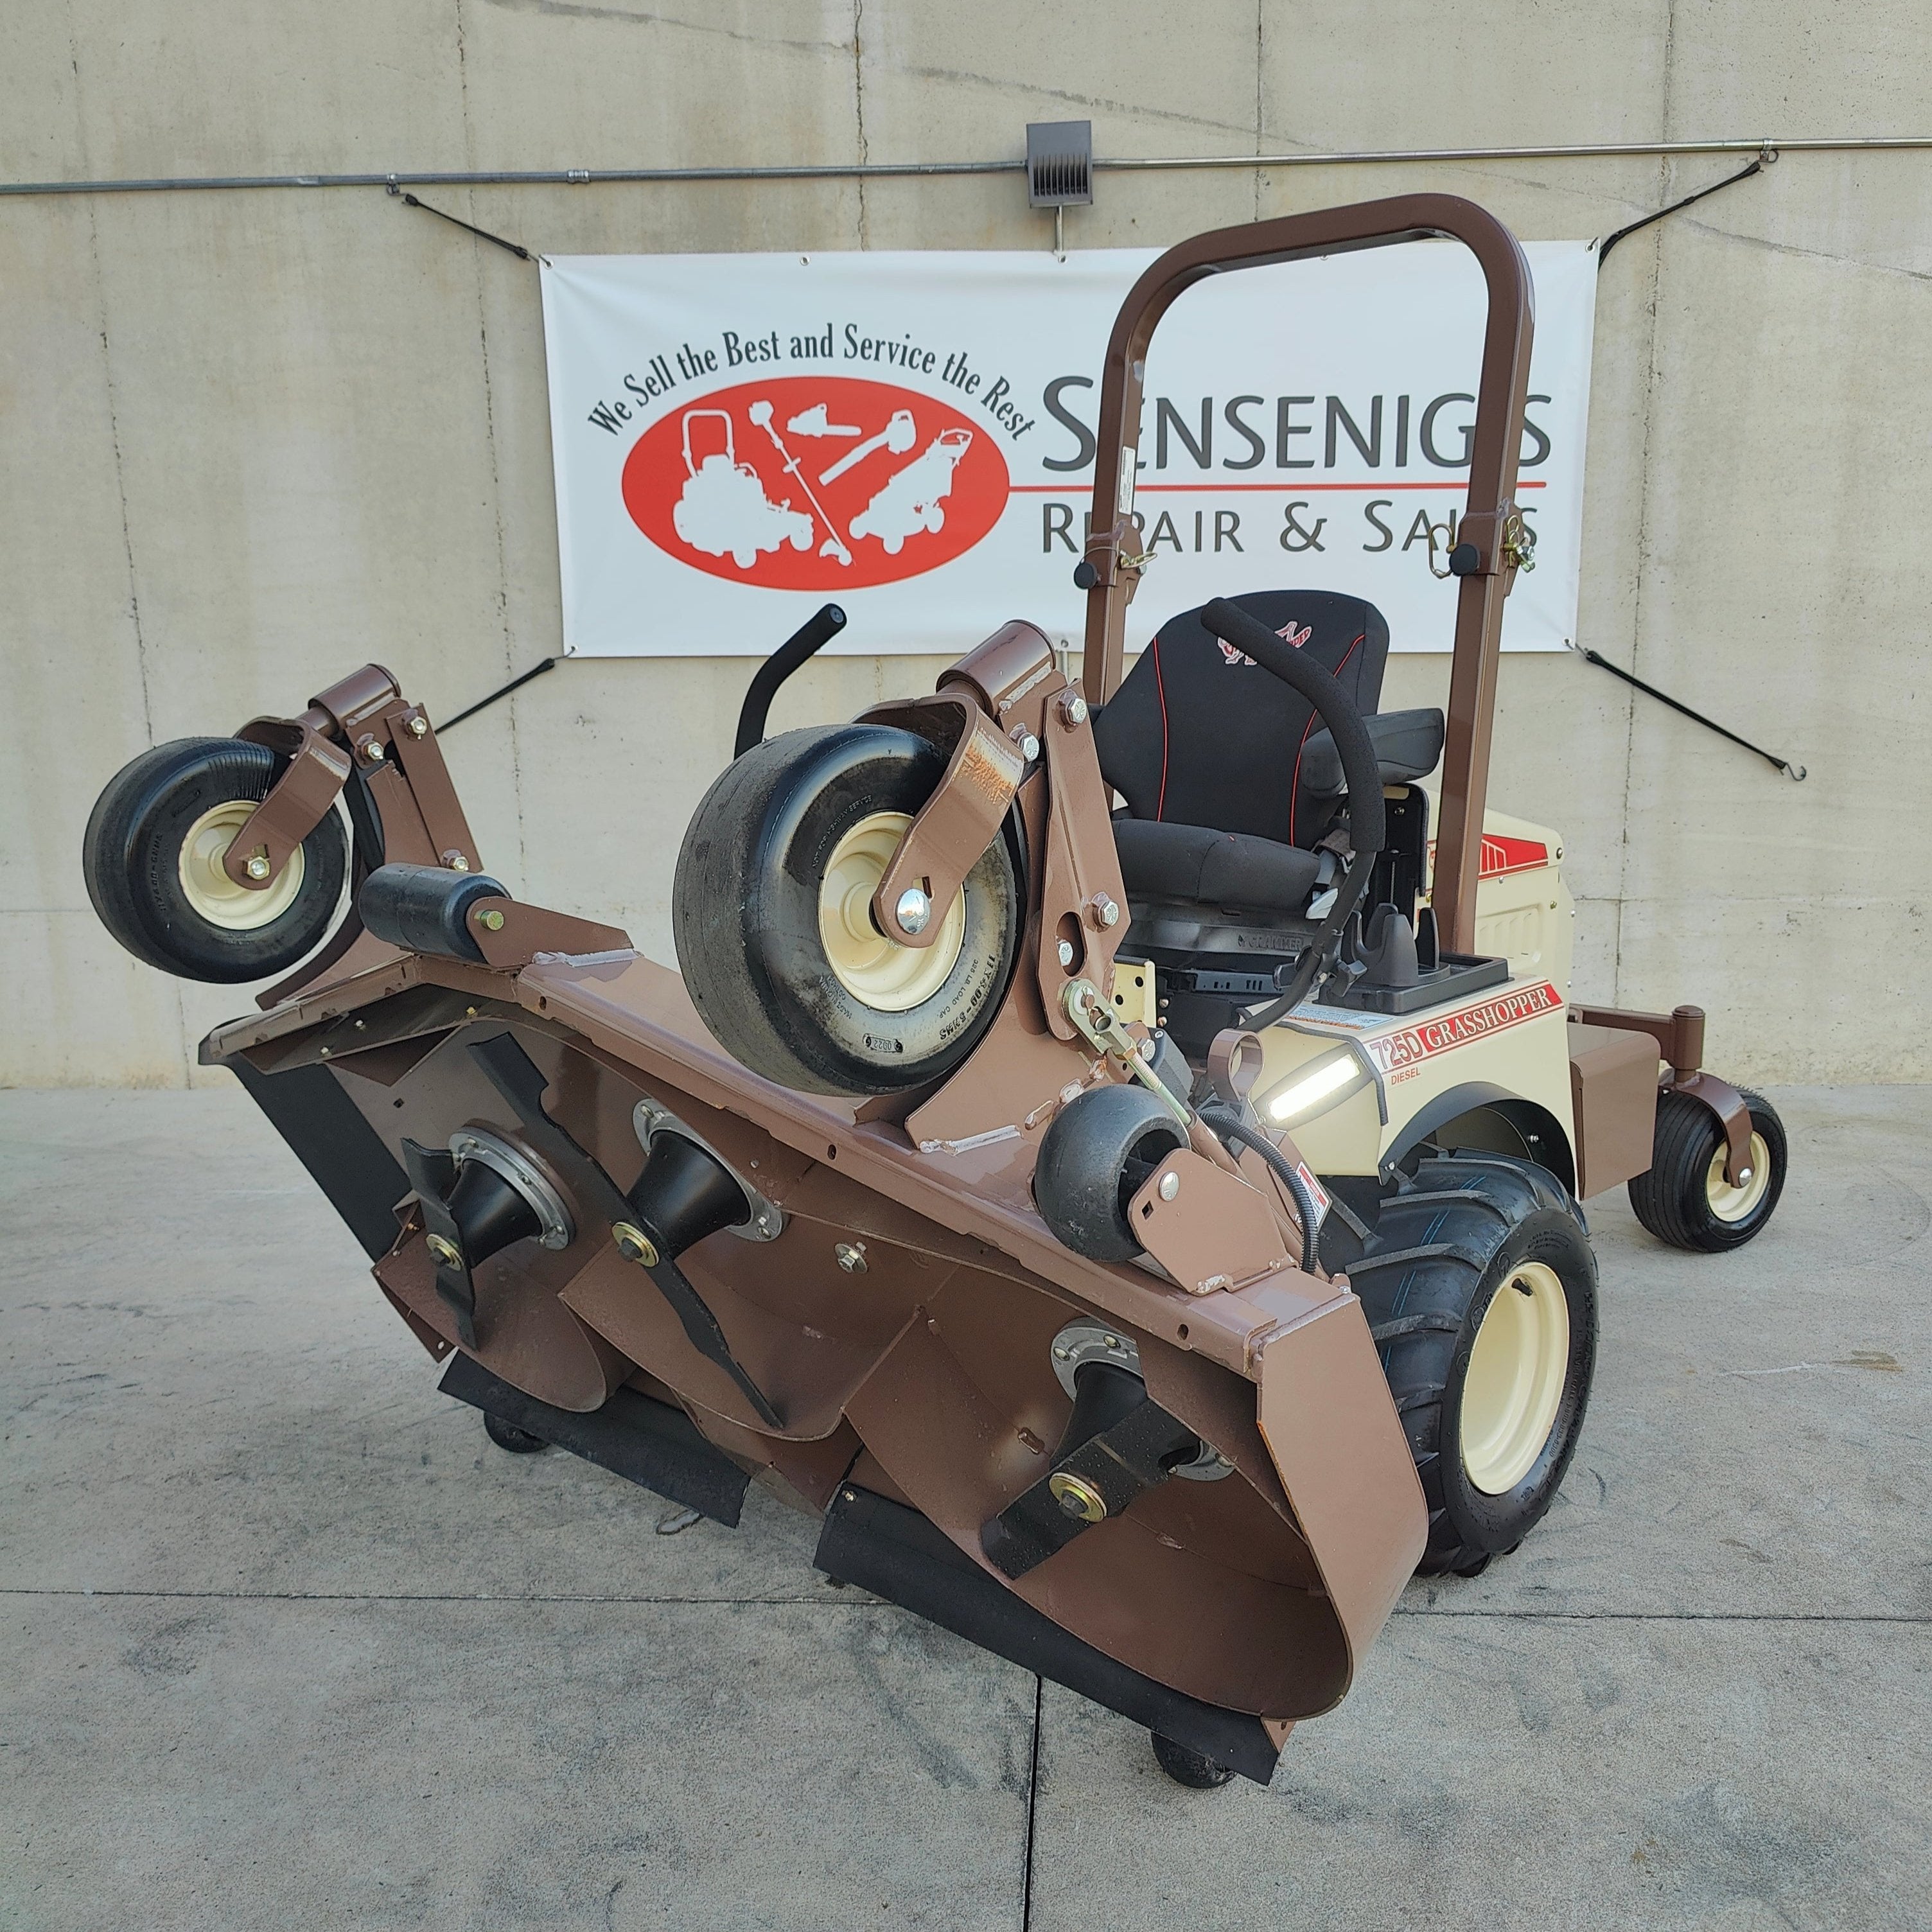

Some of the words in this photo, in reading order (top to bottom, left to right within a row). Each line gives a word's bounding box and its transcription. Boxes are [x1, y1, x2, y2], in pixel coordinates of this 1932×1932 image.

[588, 401, 632, 436] We
[624, 355, 676, 407] Sell
[677, 344, 718, 380] the
[723, 331, 780, 367] Best
[790, 323, 833, 358] and
[844, 324, 936, 374] Service
[942, 352, 981, 394] the
[981, 376, 1035, 441] Rest
[1042, 376, 1552, 471] SNSENIGS
[1280, 502, 1328, 558] &
[1362, 500, 1538, 552] SALS
[1369, 1030, 1423, 1070] 725D
[1425, 987, 1552, 1049] GRASSHOPPER
[1391, 1066, 1421, 1085] DIESEL
